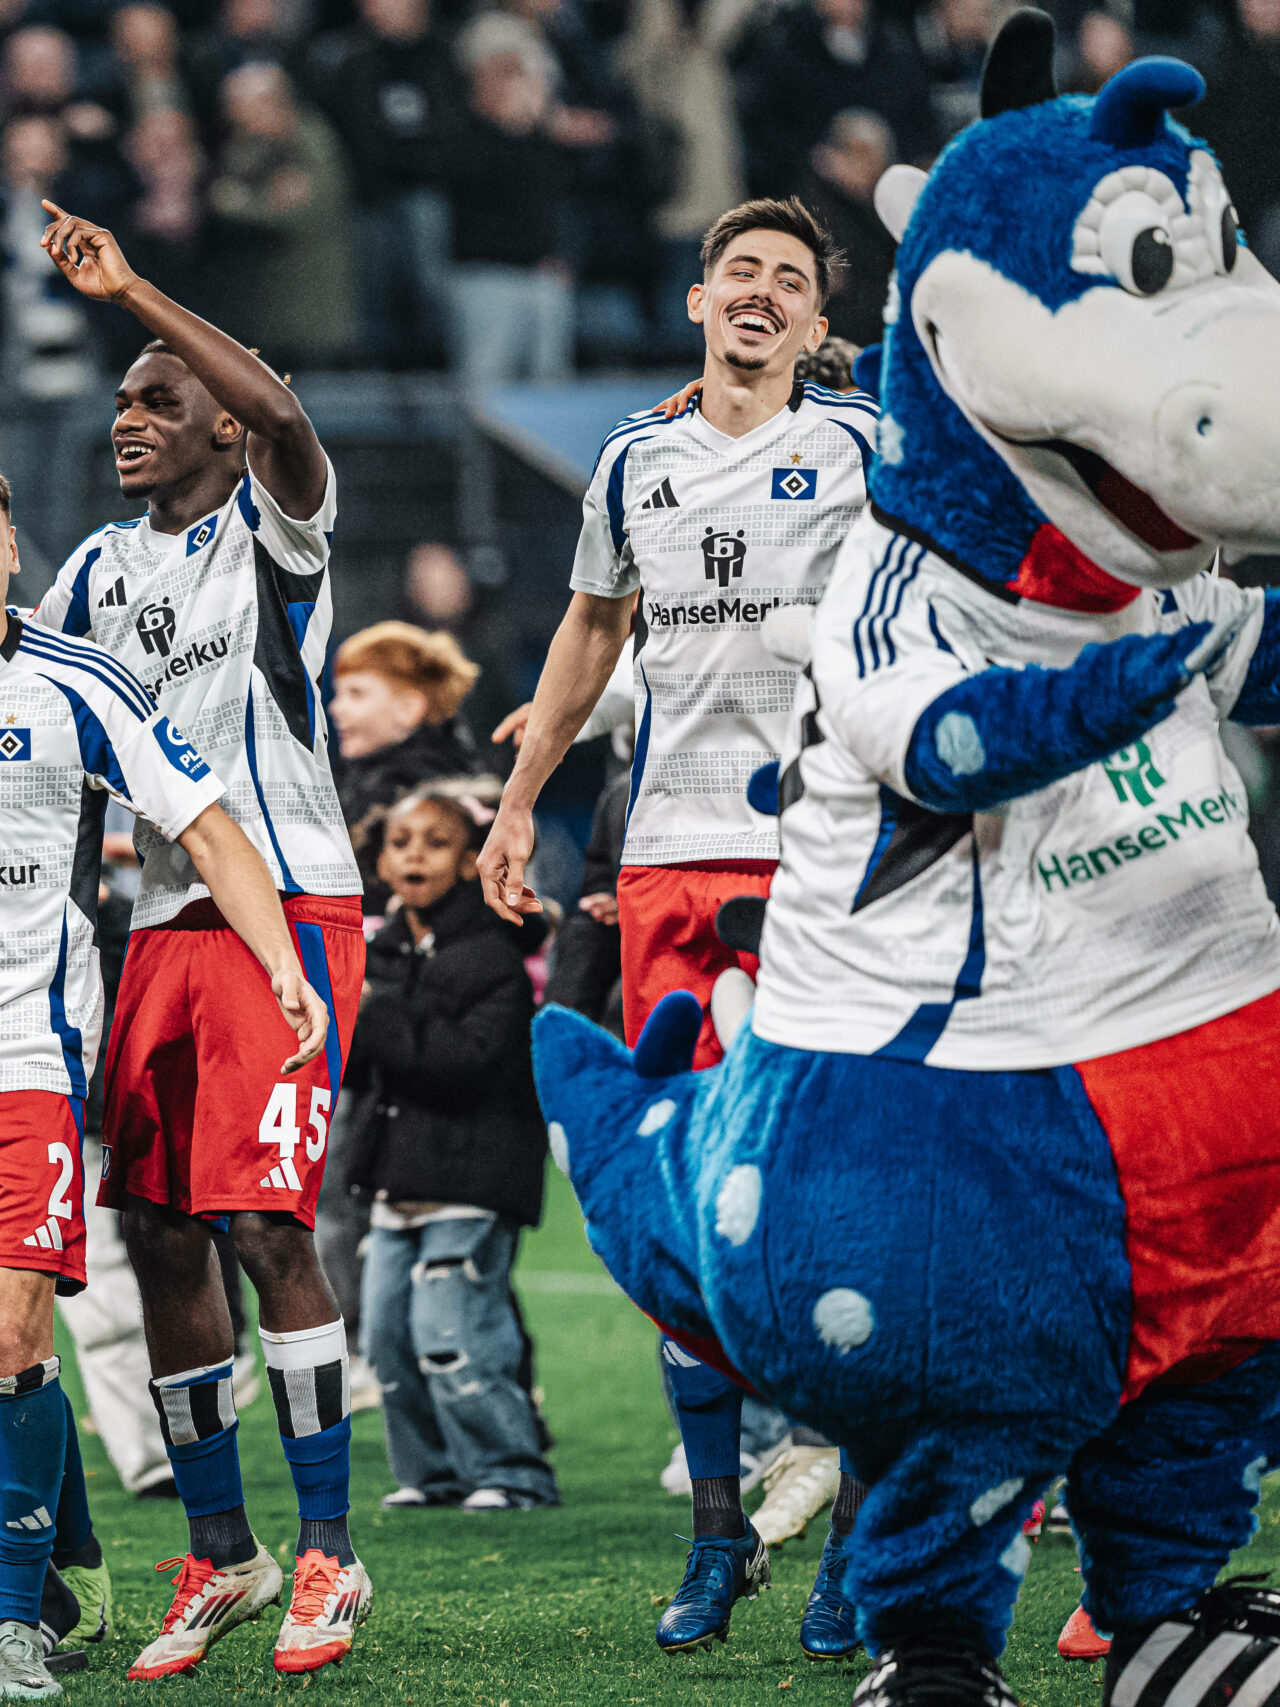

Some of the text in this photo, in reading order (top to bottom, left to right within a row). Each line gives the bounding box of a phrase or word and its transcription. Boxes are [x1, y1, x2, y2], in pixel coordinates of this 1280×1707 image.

[648, 597, 782, 626] HanseMer
[258, 1082, 332, 1163] 45
[47, 1141, 74, 1221] 2
